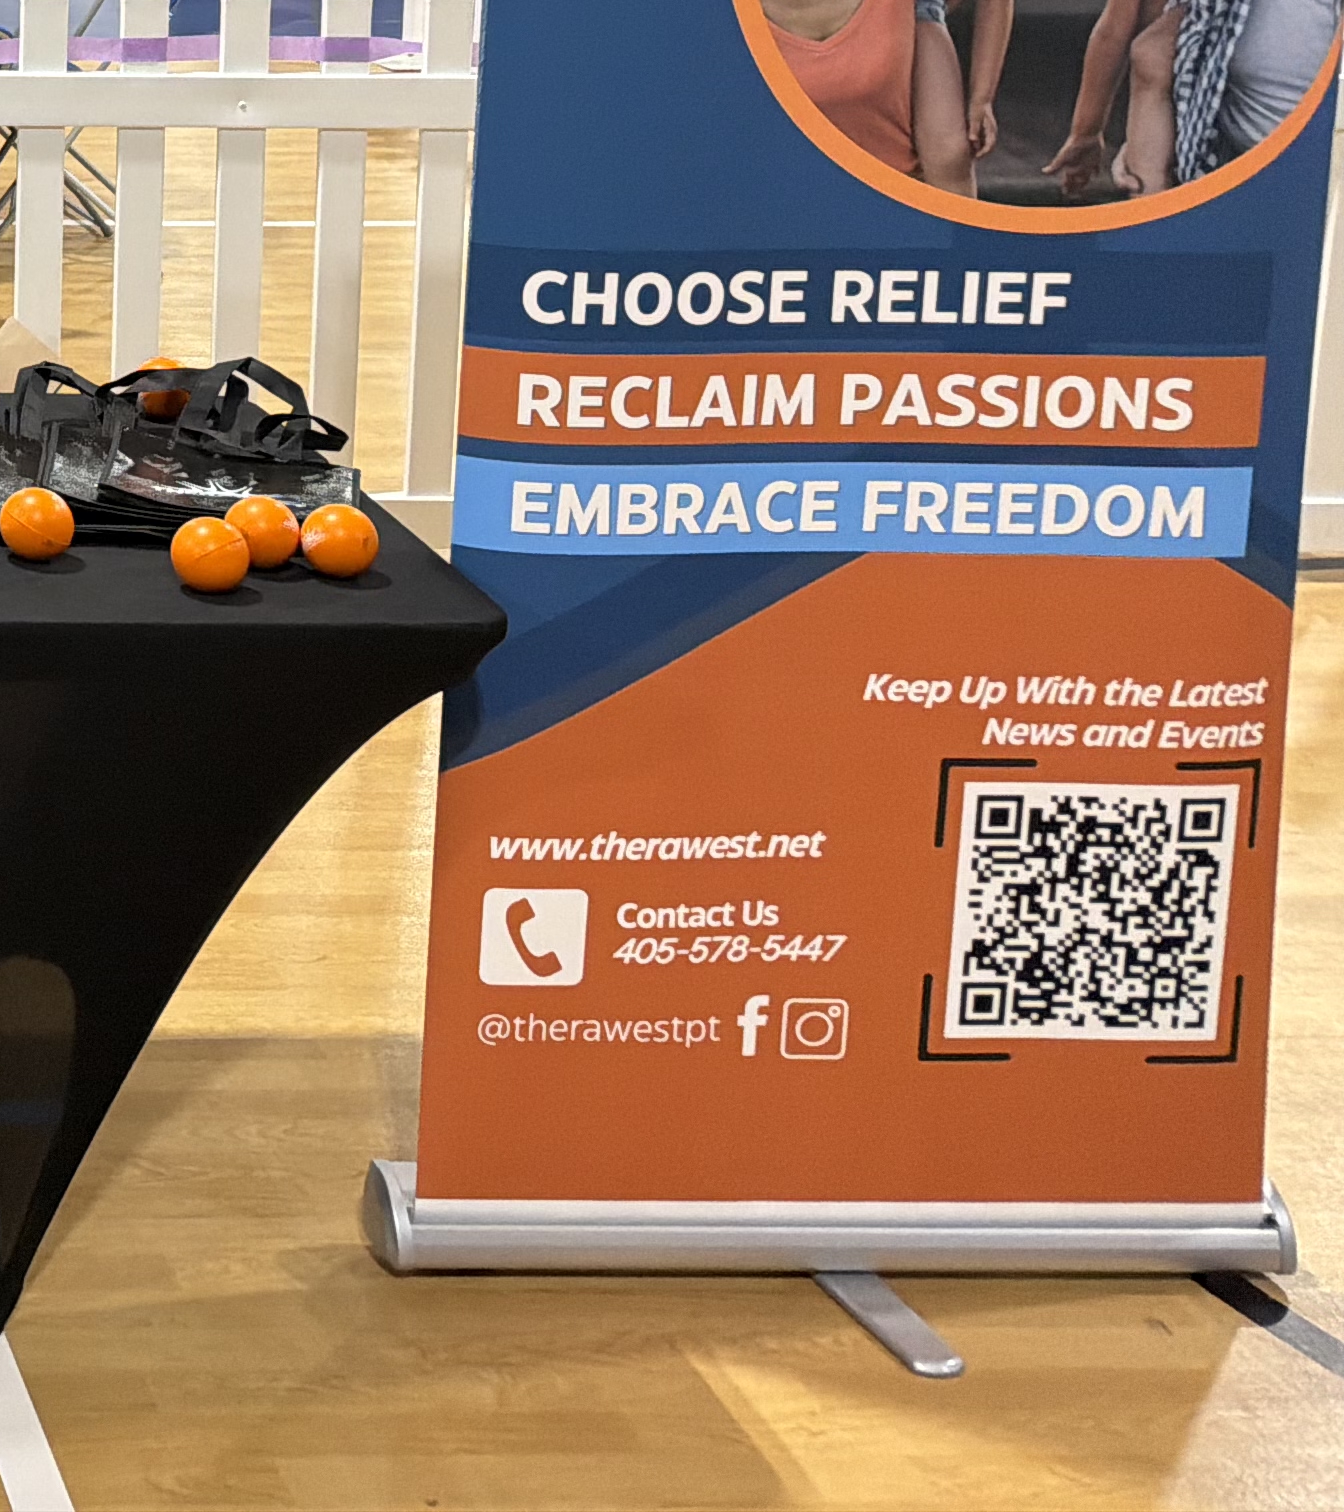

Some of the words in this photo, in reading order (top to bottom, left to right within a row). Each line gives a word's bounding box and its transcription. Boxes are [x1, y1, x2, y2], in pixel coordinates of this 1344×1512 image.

[522, 269, 809, 326] CHOOSE
[830, 269, 1072, 325] RELIEF
[516, 373, 815, 429] RECLAIM
[840, 373, 1193, 432] PASSIONS
[510, 480, 840, 536] EMBRACE
[861, 480, 1205, 538] FREEDOM
[862, 673, 953, 709] Keep
[960, 675, 1008, 710] Up
[1016, 675, 1097, 705] With
[1103, 677, 1164, 708] the
[1168, 677, 1269, 708] Latest
[981, 717, 1078, 747] News
[1082, 718, 1156, 749] and
[1157, 720, 1265, 749] Events
[490, 830, 827, 861] www.therawest.net
[616, 902, 736, 929] Contact
[742, 900, 779, 927] Us
[613, 934, 848, 965] 405-578-5447
[477, 1012, 721, 1049] @therawestpt
